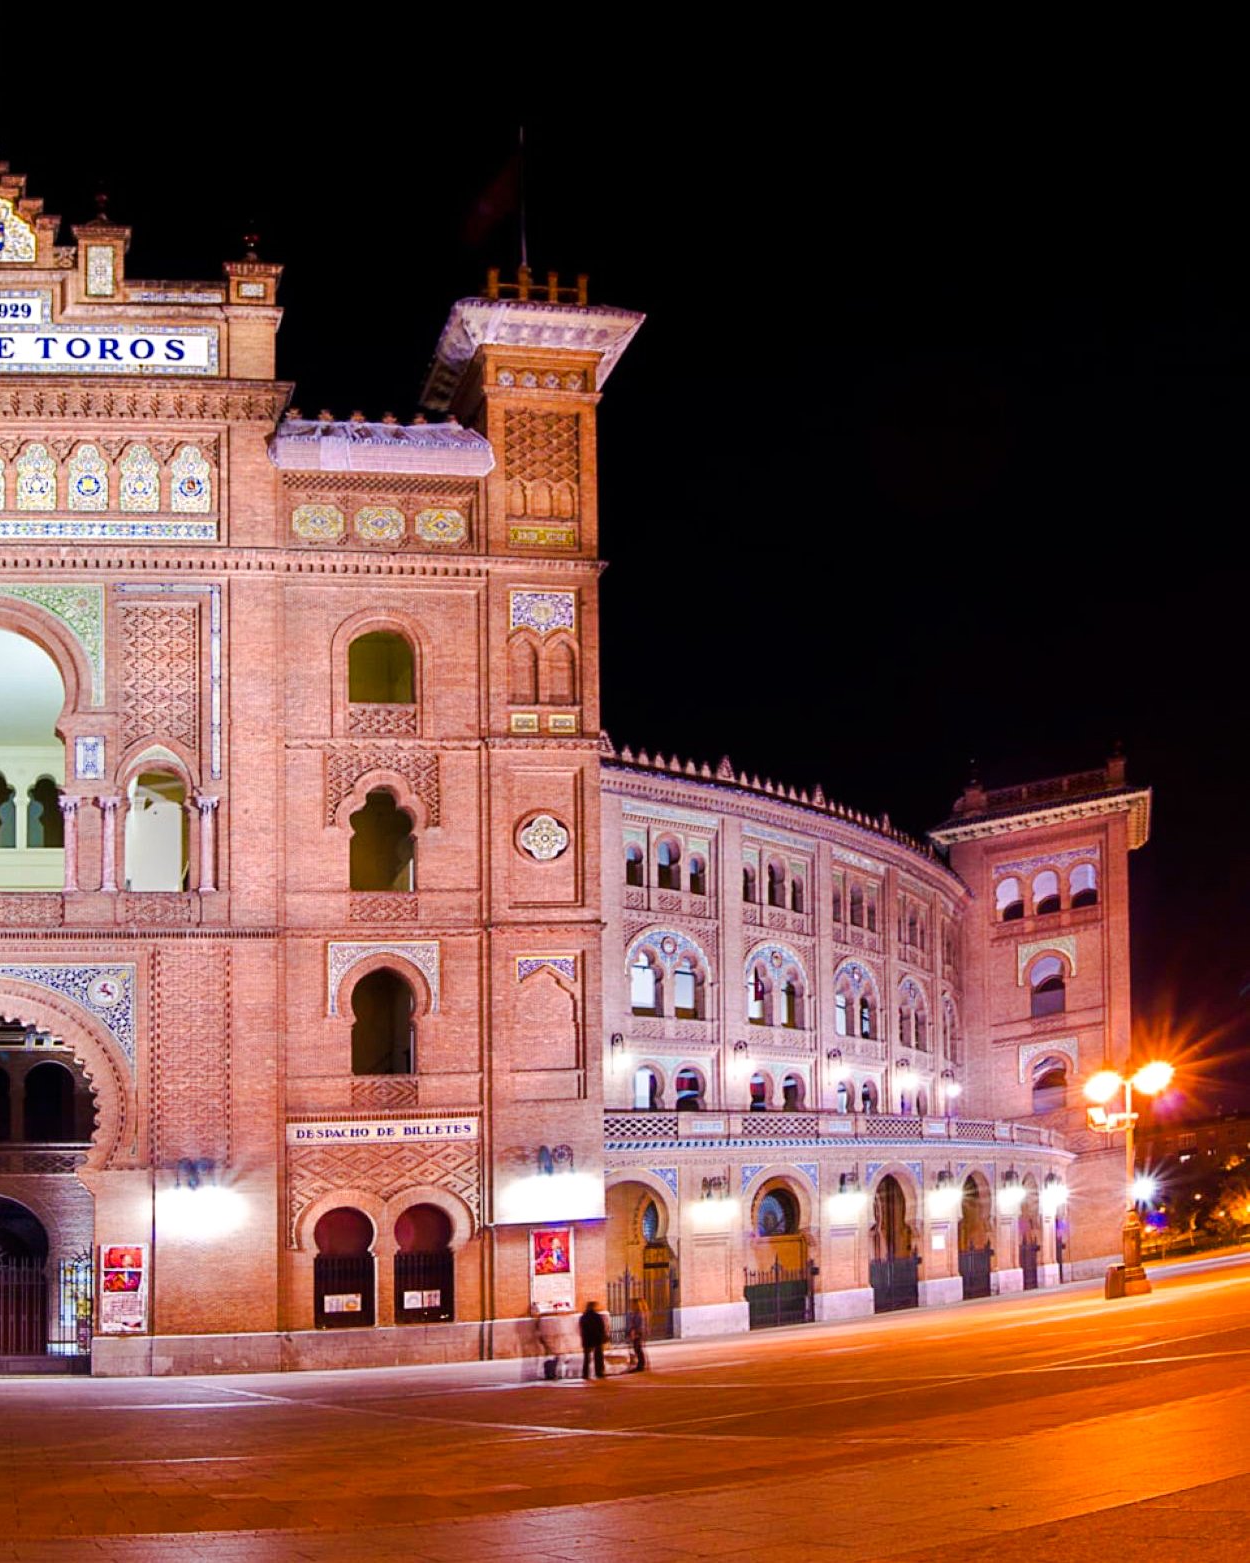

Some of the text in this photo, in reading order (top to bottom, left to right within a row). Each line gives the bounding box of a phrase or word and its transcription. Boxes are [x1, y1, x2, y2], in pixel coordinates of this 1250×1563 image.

[35, 337, 186, 361] TOROS
[296, 1124, 472, 1139] DESPACHO DE BILLETES
